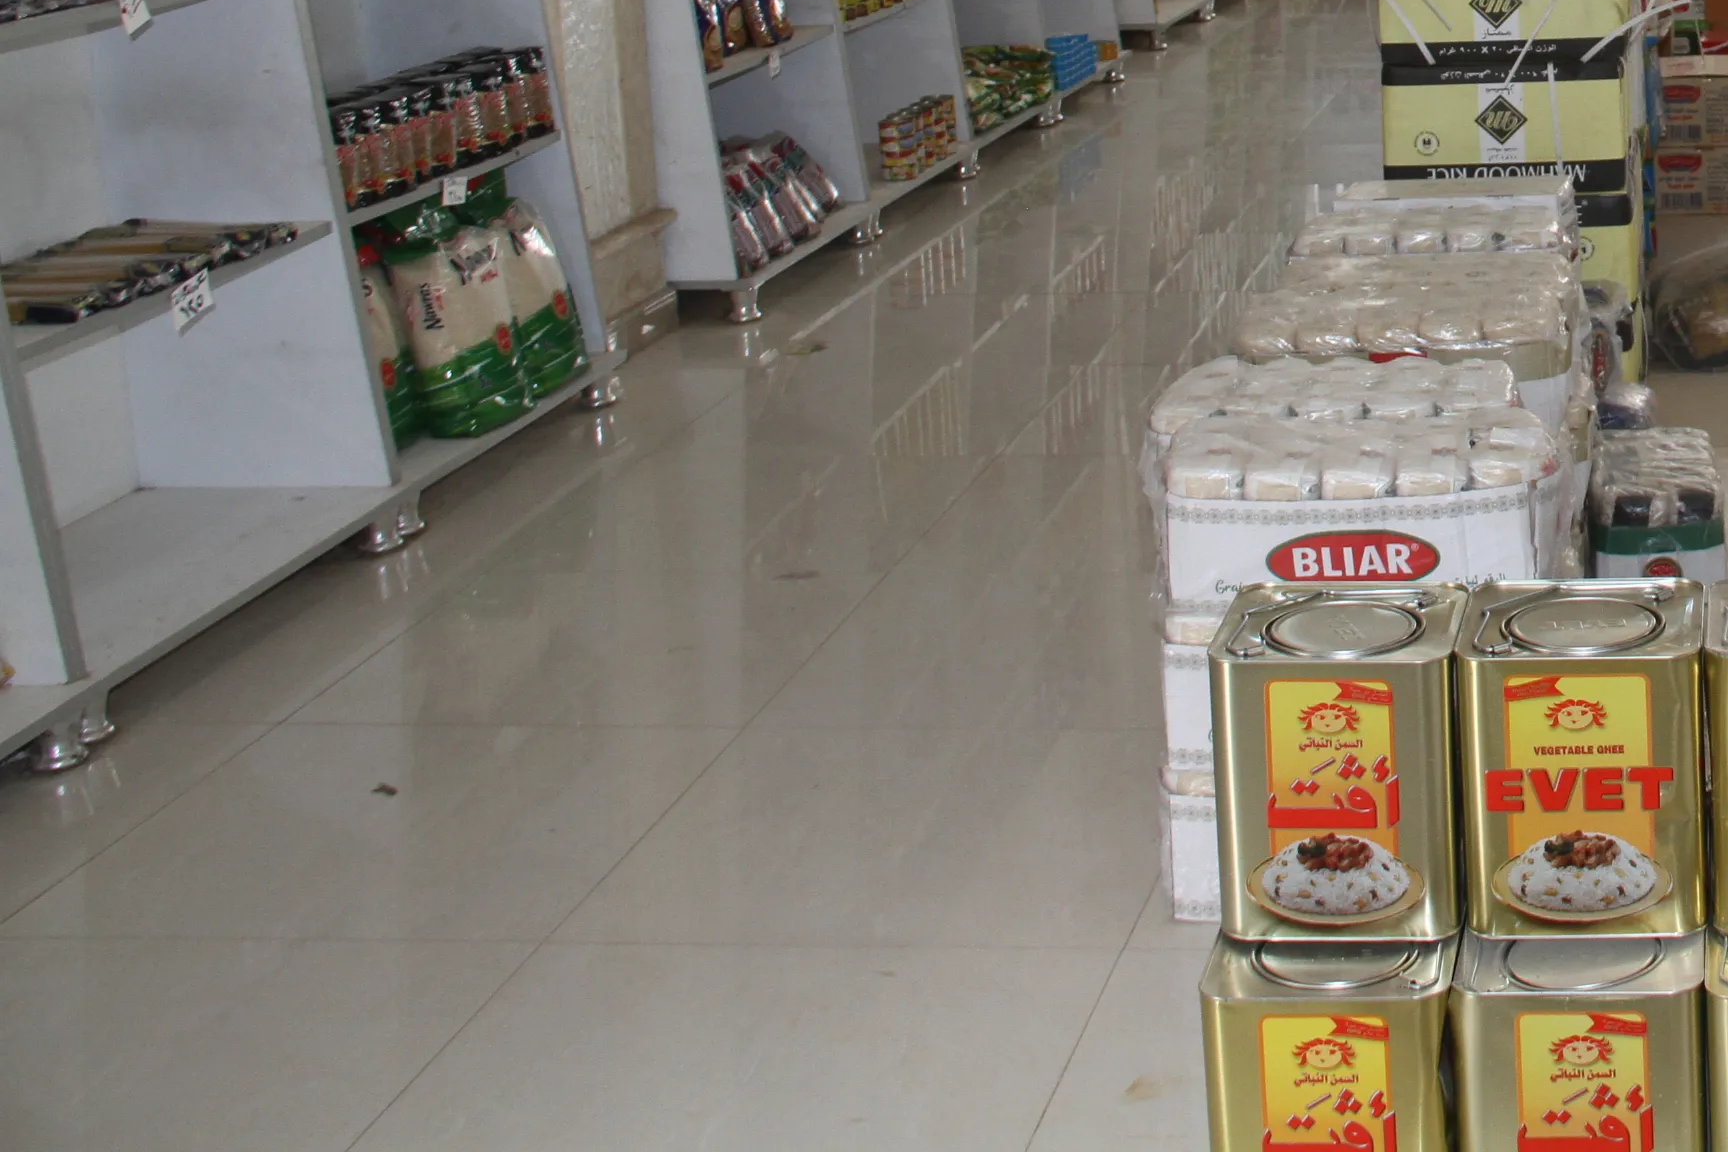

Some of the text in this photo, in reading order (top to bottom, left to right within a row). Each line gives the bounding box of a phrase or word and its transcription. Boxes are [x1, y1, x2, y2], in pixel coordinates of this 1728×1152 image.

[1291, 543, 1414, 578] BLIAR
[1298, 737, 1363, 752] السمن النباتي
[1533, 744, 1625, 756] VEGETABLE GHEE
[1484, 767, 1674, 813] EVET
[1294, 1072, 1359, 1087] السمن النباتي
[1550, 1067, 1616, 1082] السمن النباتي
